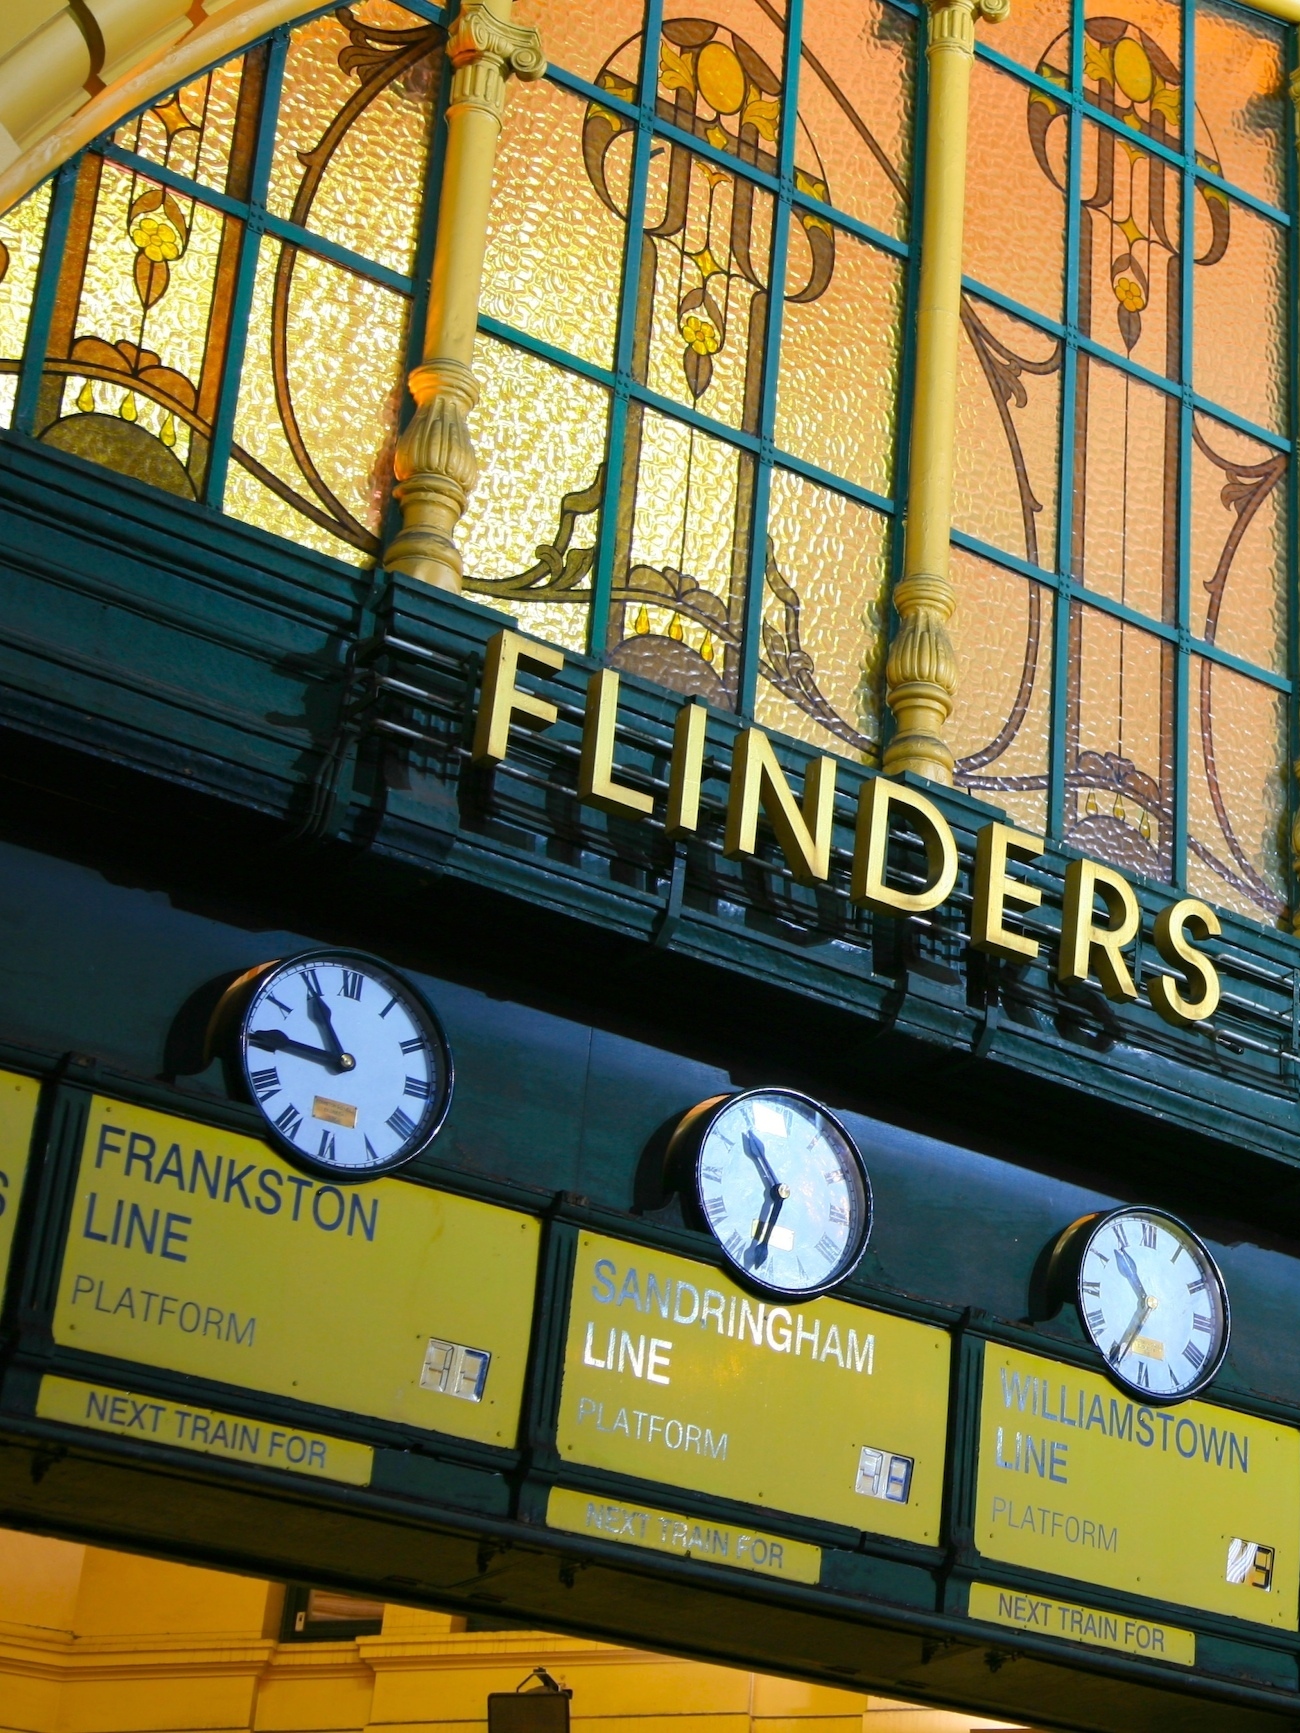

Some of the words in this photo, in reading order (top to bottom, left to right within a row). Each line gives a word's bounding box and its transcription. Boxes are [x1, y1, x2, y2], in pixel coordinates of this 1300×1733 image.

[472, 629, 1222, 1027] FLINDERS
[94, 1124, 379, 1242] FRANKSTON
[83, 1192, 193, 1263] LINE
[71, 1274, 257, 1347] PLATFORM
[591, 1259, 875, 1375] SANDRINGHAM
[583, 1322, 672, 1385] LINE
[86, 1391, 167, 1430] NEXT
[173, 1412, 263, 1455] TRAIN
[269, 1431, 327, 1469] FOR
[576, 1398, 729, 1461] PLATFORM
[1000, 1366, 1249, 1474] WILLIAMSTOWN
[995, 1427, 1068, 1485] LINE
[586, 1502, 652, 1539] NEXT
[657, 1517, 729, 1556] TRAIN
[736, 1536, 784, 1569] FOR
[991, 1496, 1118, 1553] PLATFORM
[999, 1593, 1053, 1627] NEXT
[1057, 1606, 1118, 1643] TRAIN
[1124, 1624, 1165, 1653] FOR
